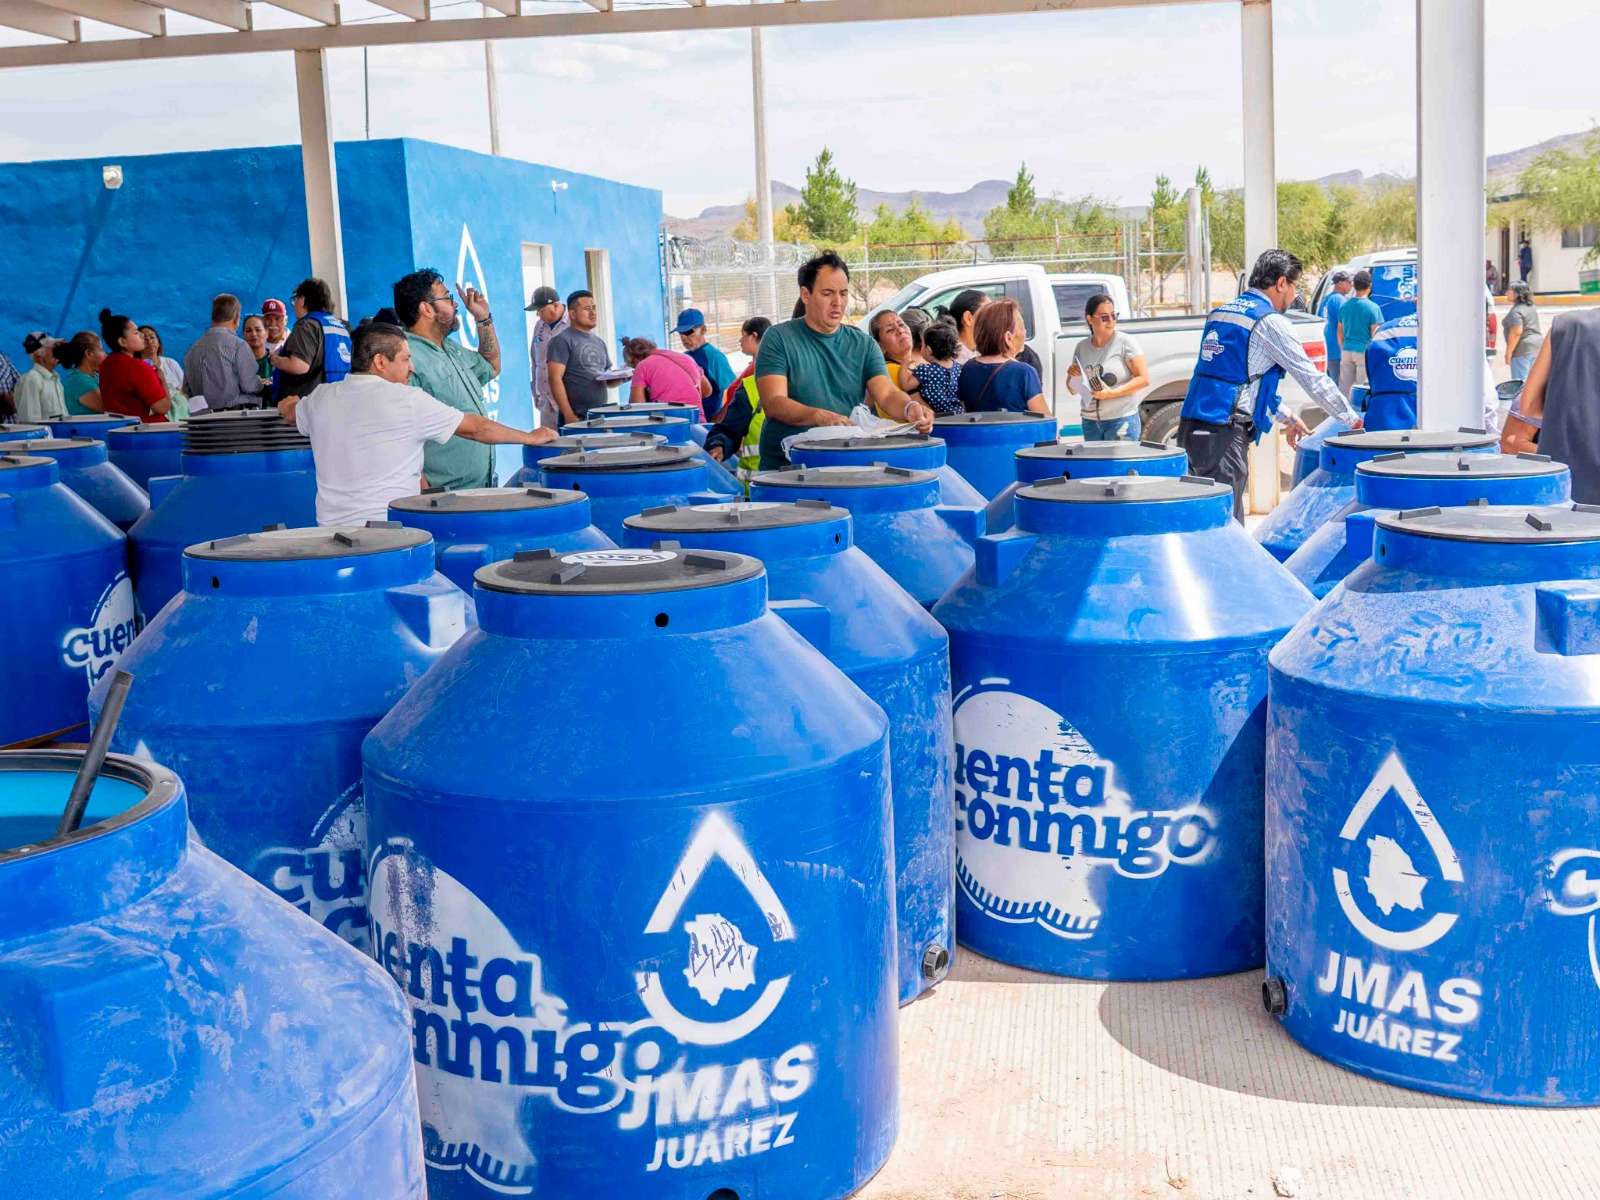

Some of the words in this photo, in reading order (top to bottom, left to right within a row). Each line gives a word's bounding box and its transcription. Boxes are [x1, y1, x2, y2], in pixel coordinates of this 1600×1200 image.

[1389, 355, 1417, 364] cuent
[67, 617, 137, 662] cuen
[955, 743, 1105, 808] enta
[374, 920, 533, 1018] enta
[1317, 951, 1483, 1024] JMAS
[413, 1008, 681, 1099] nmigo
[1332, 1009, 1463, 1061] JUÁREZ
[618, 1043, 818, 1131] JMAS
[645, 1111, 799, 1172] JUÁREZ
